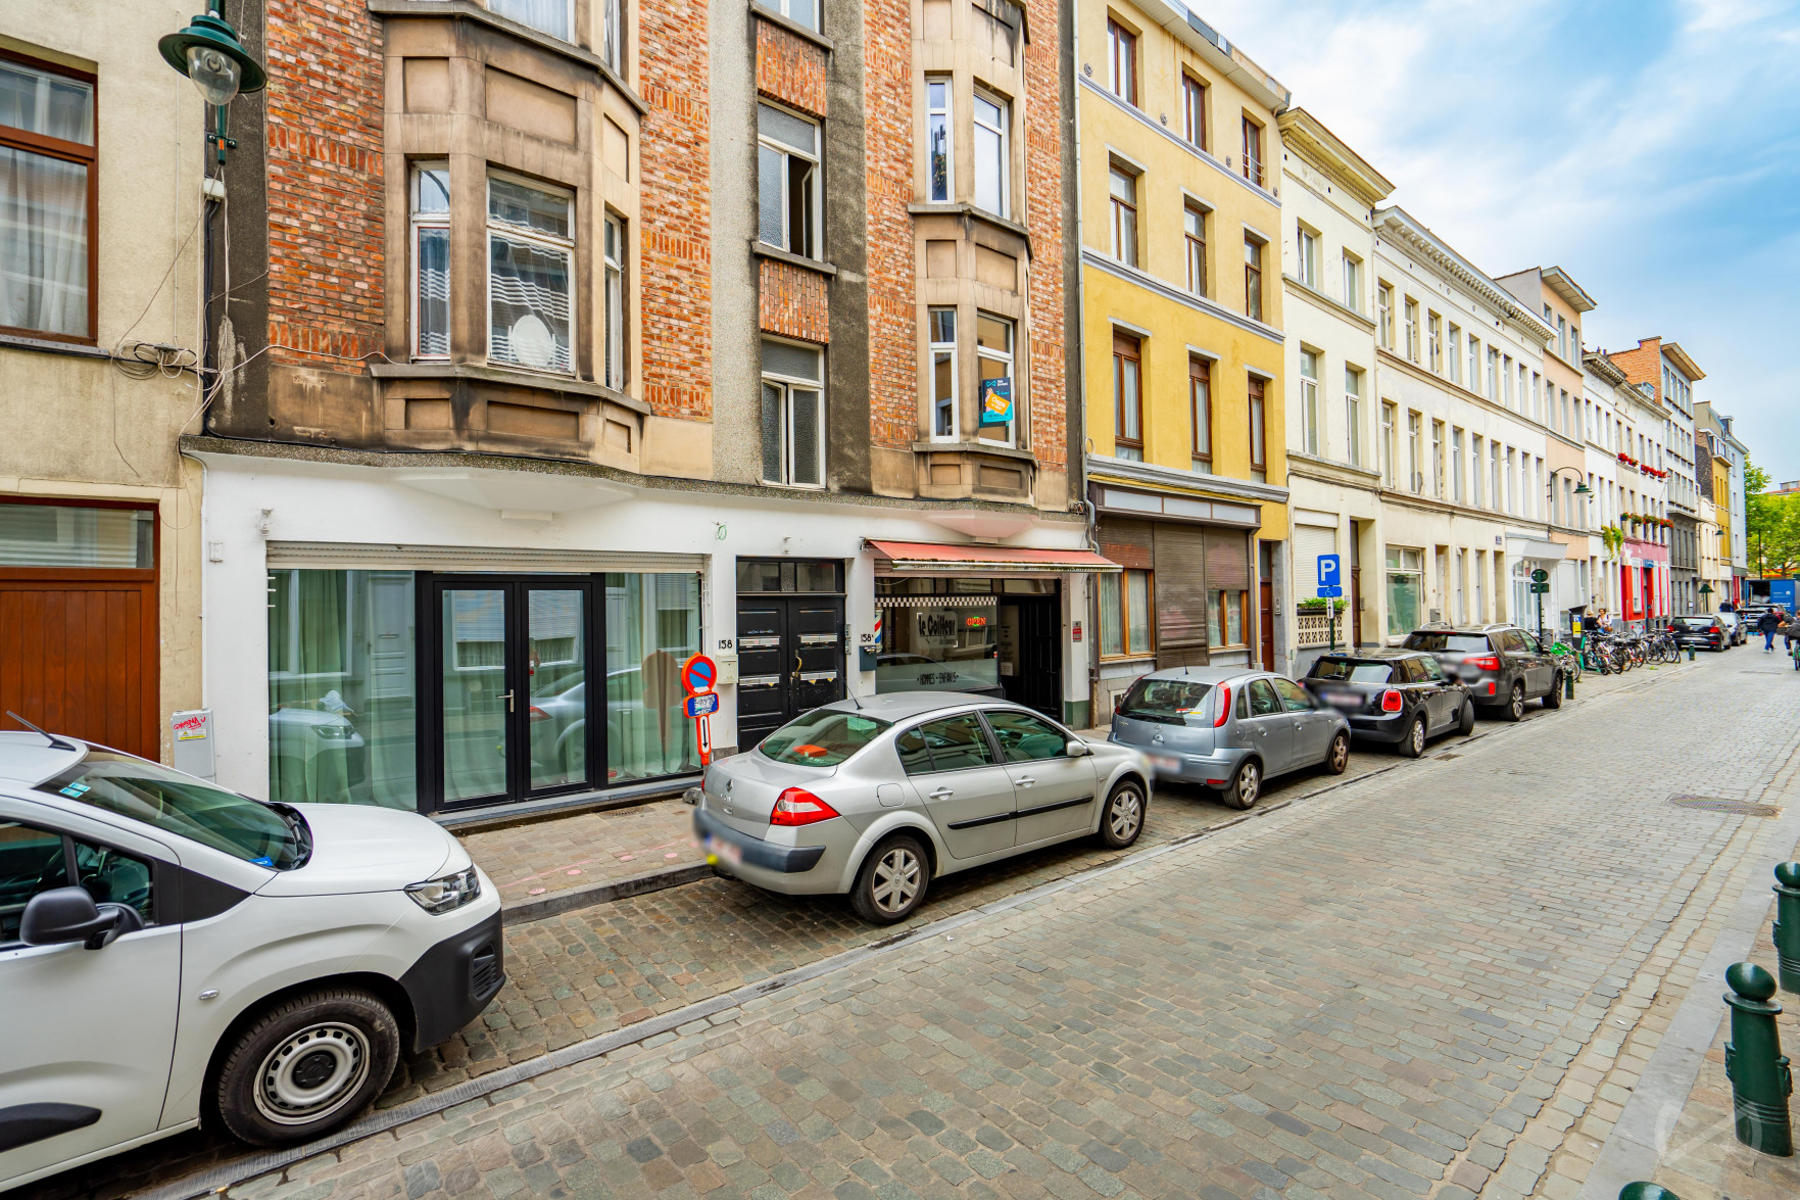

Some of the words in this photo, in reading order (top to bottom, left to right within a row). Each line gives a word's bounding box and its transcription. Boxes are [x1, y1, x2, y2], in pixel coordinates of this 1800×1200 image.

[1320, 559, 1336, 582] P
[966, 616, 987, 626] OPEN
[718, 639, 733, 650] 158
